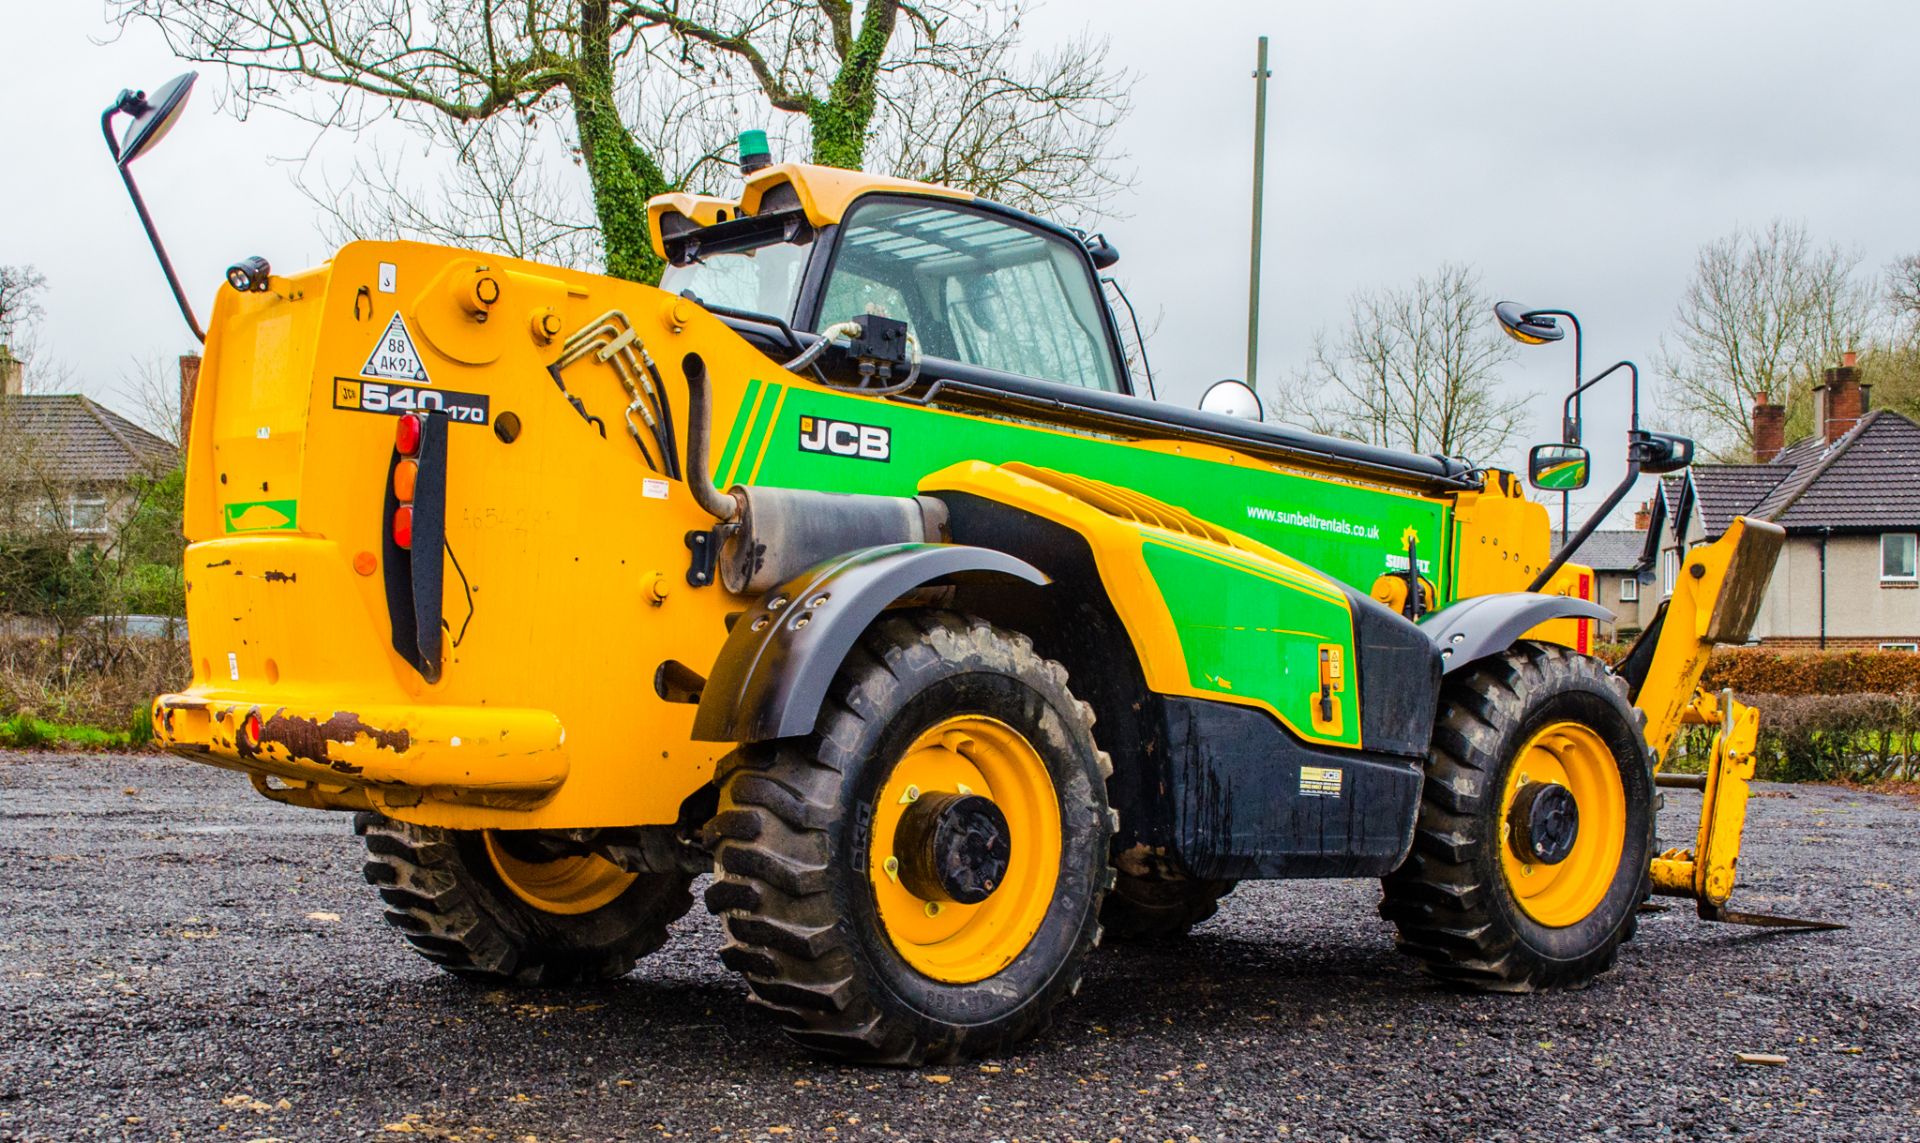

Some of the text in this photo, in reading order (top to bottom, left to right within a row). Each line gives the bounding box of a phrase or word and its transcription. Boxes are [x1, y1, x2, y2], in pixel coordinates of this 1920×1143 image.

[388, 338, 405, 354] 88
[342, 386, 357, 401] JCB
[800, 419, 890, 460] JCB
[1246, 505, 1380, 540] www.sunbeltrentals.co.uk
